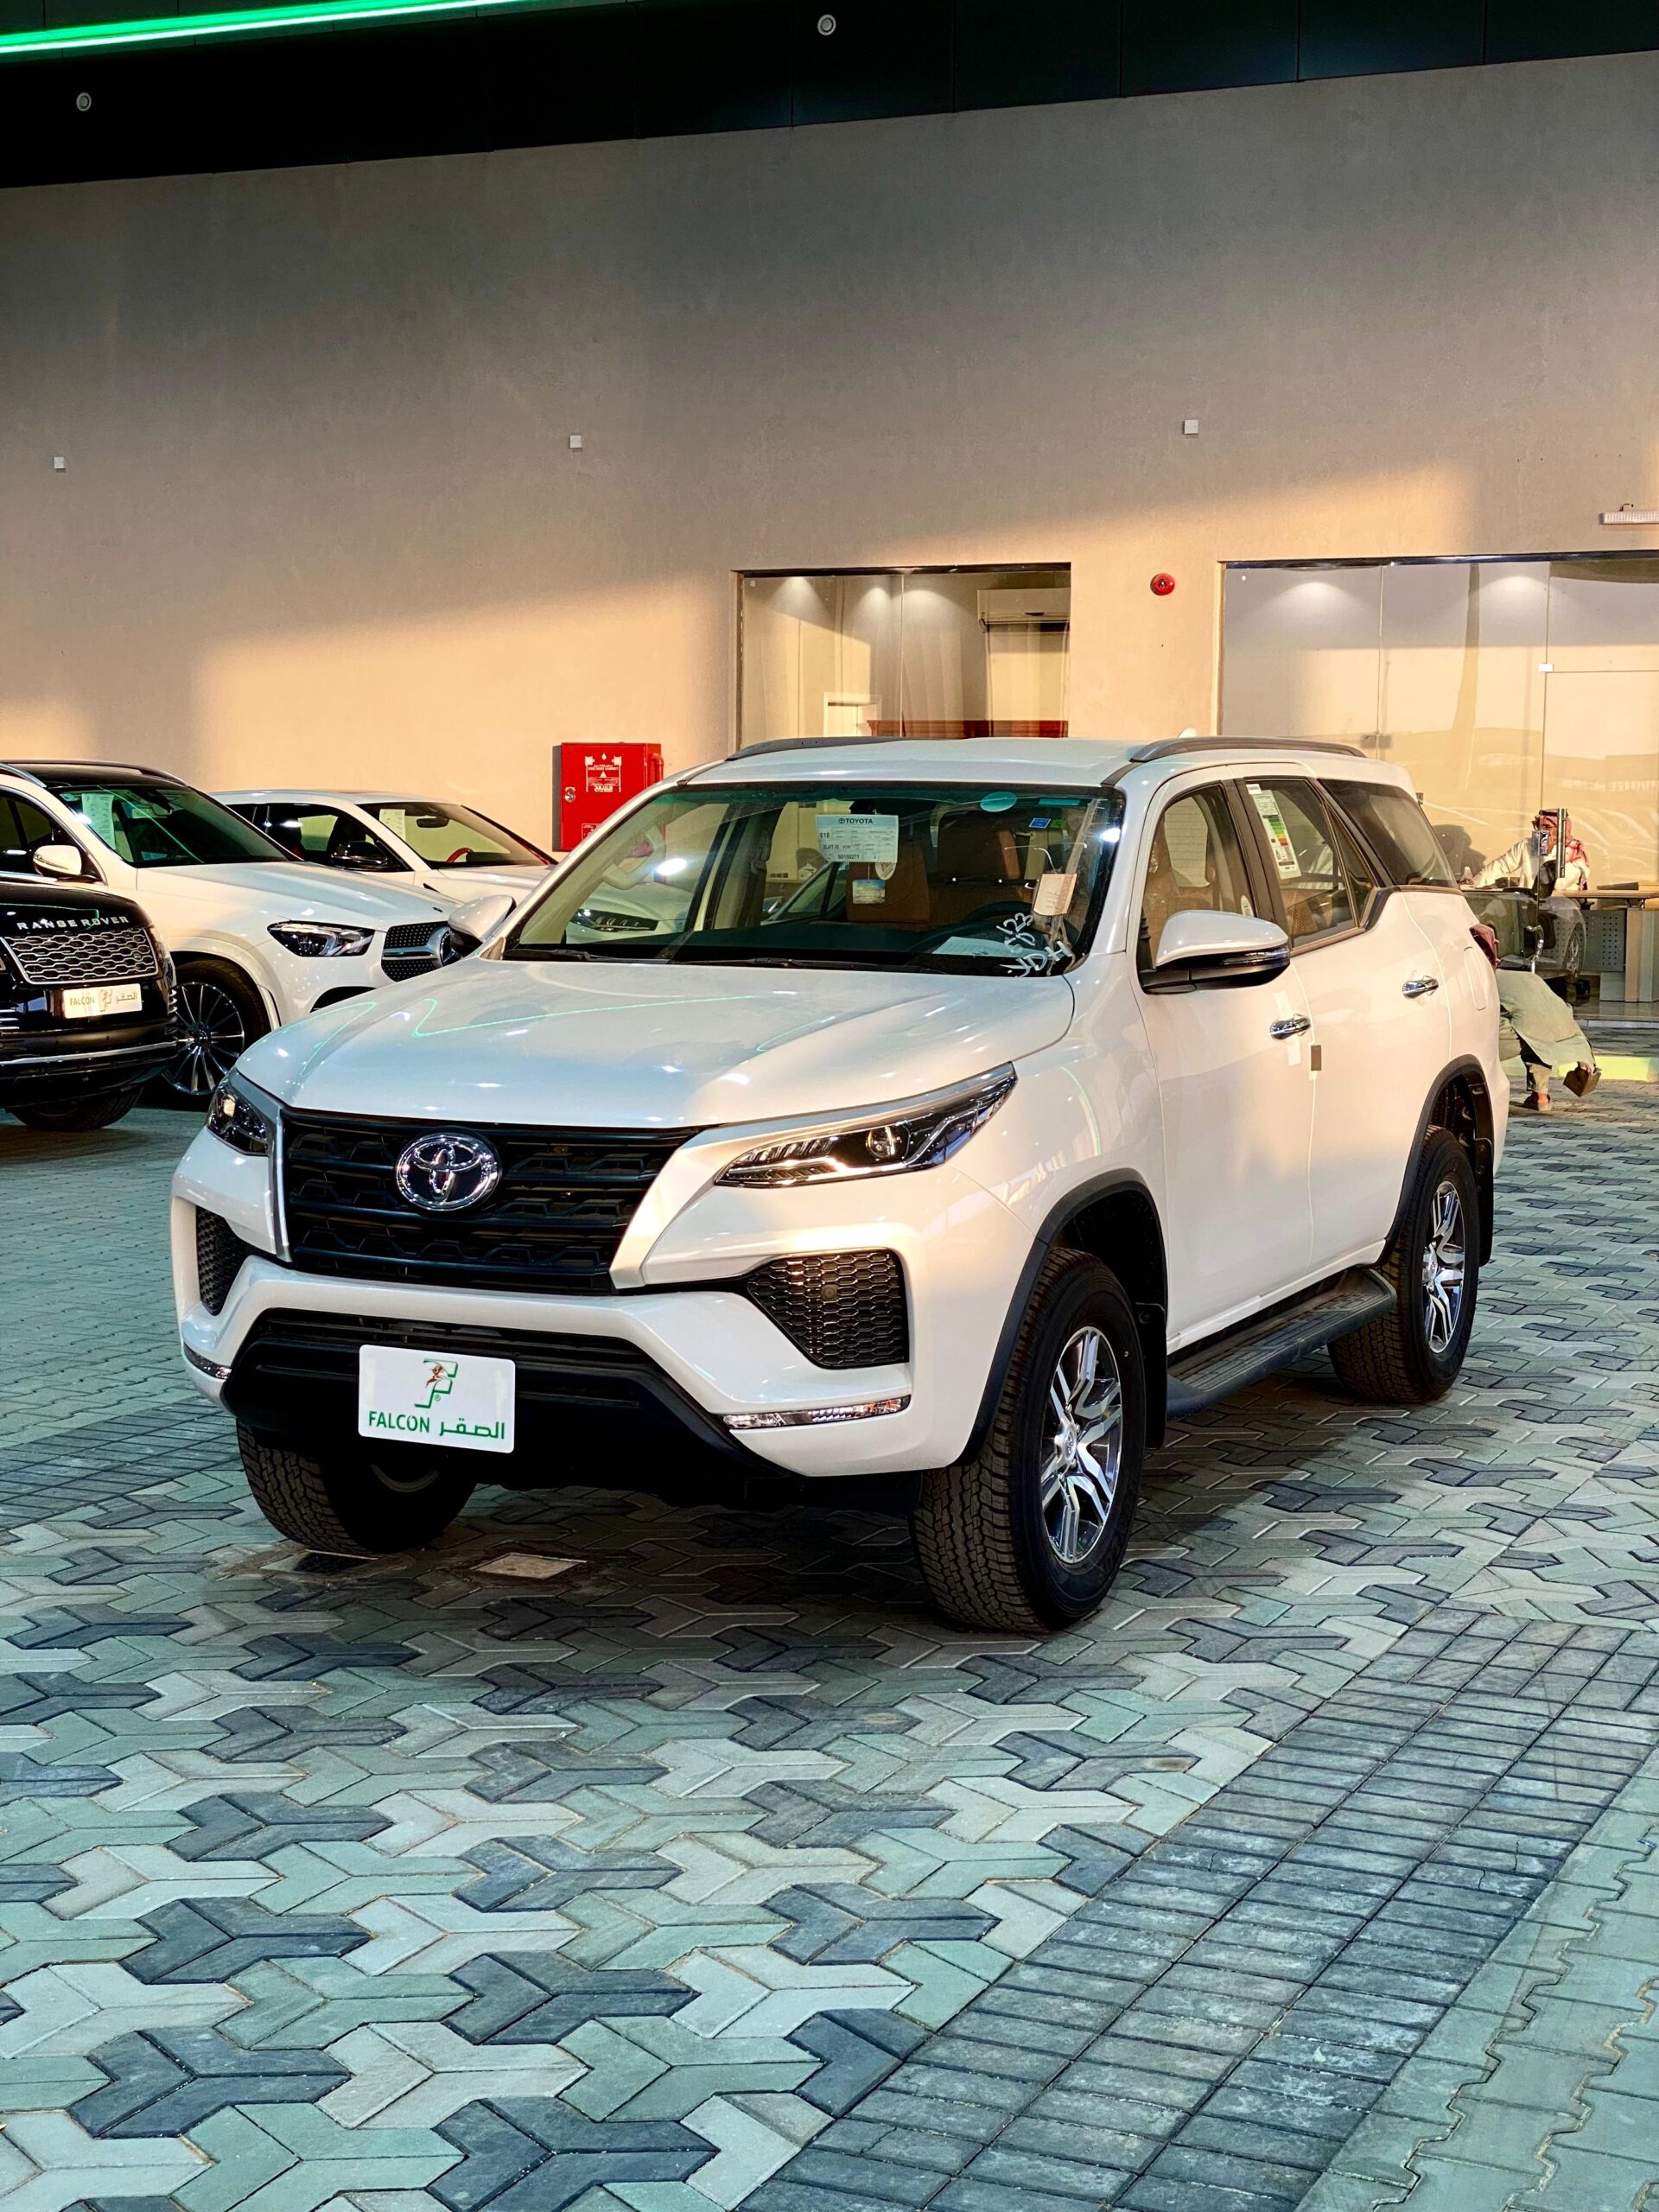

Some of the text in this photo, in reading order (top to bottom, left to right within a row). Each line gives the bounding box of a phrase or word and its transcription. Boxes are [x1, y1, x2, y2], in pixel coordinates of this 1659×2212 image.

[16, 916, 130, 931] RANGE ROVER
[69, 995, 96, 1007] FALCON
[116, 991, 138, 1005] الصقر
[368, 1410, 430, 1433] FALCON
[439, 1417, 505, 1440] الصقر
